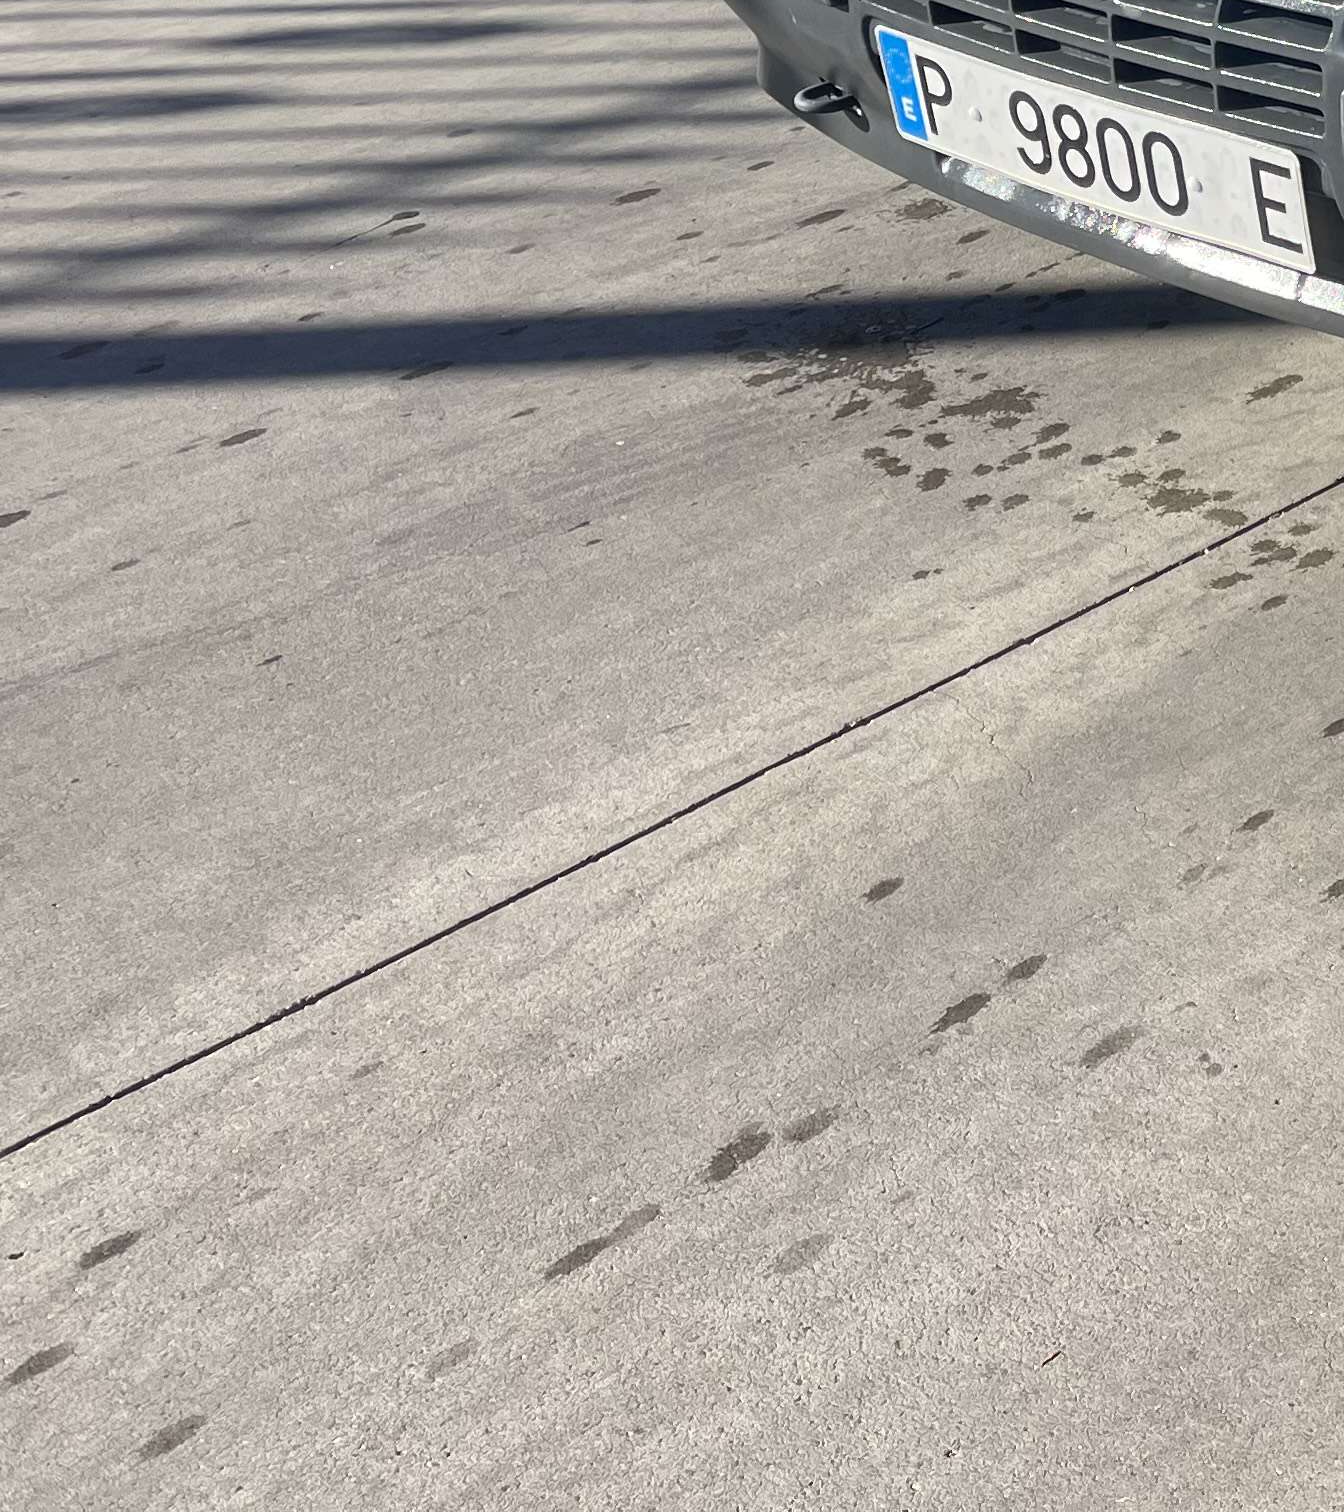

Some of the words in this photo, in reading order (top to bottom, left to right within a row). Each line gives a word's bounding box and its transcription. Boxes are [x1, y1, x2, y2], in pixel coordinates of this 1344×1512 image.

[901, 96, 917, 121] E
[915, 54, 953, 136] P
[1009, 90, 1189, 217] 9800
[1249, 156, 1304, 255] E
